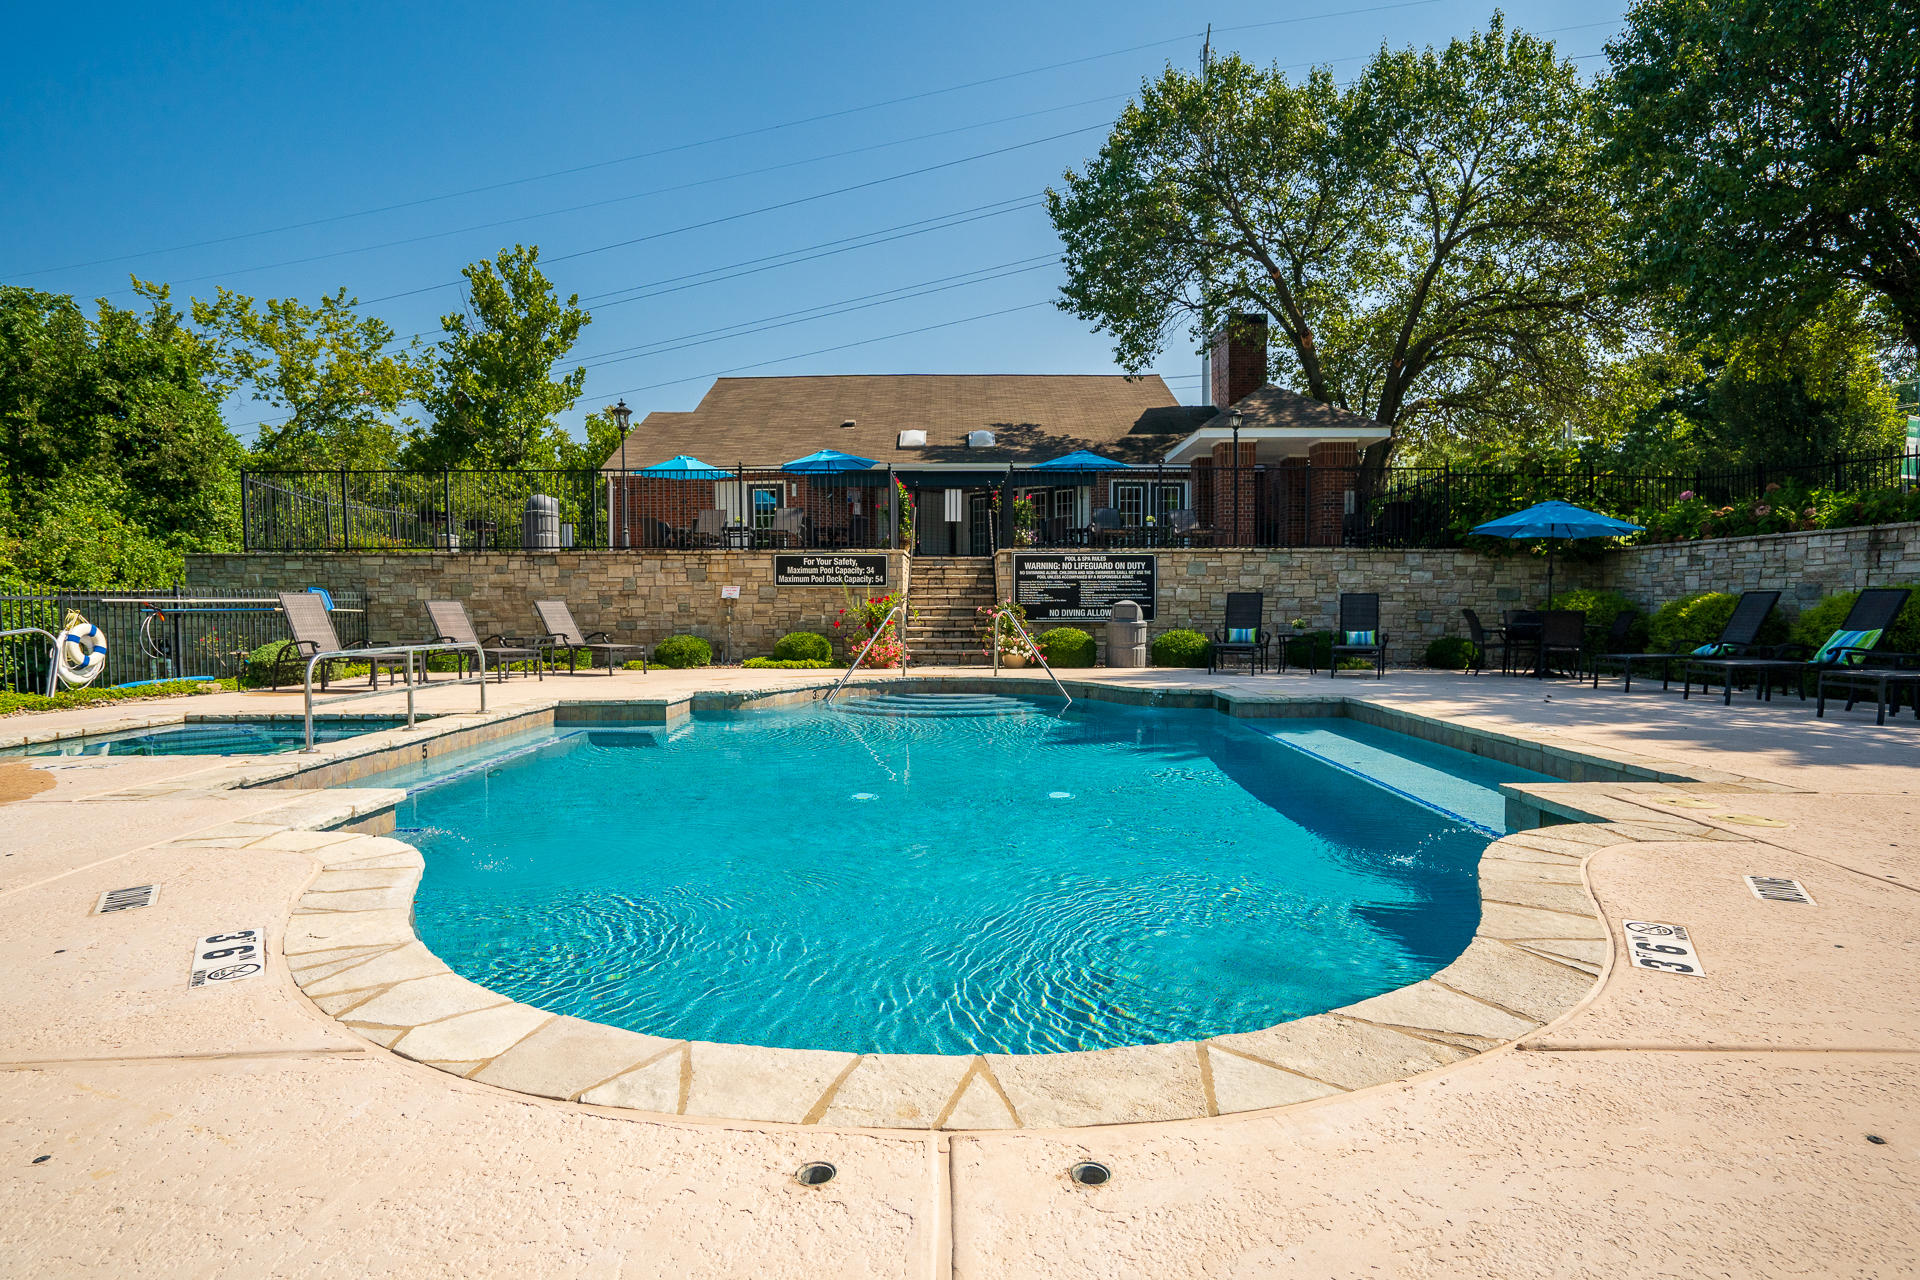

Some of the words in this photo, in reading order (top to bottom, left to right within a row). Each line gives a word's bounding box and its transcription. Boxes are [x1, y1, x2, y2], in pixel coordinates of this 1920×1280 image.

[804, 558, 815, 566] For
[816, 558, 832, 566] Your
[834, 558, 858, 566] Safety,
[835, 566, 865, 575] Capacity:
[844, 575, 874, 584] Capacity:
[813, 690, 816, 699] 3
[422, 744, 427, 759] 5
[206, 931, 254, 943] 3
[202, 946, 254, 959] 6
[1636, 942, 1687, 955] 6
[1640, 958, 1694, 972] 3
